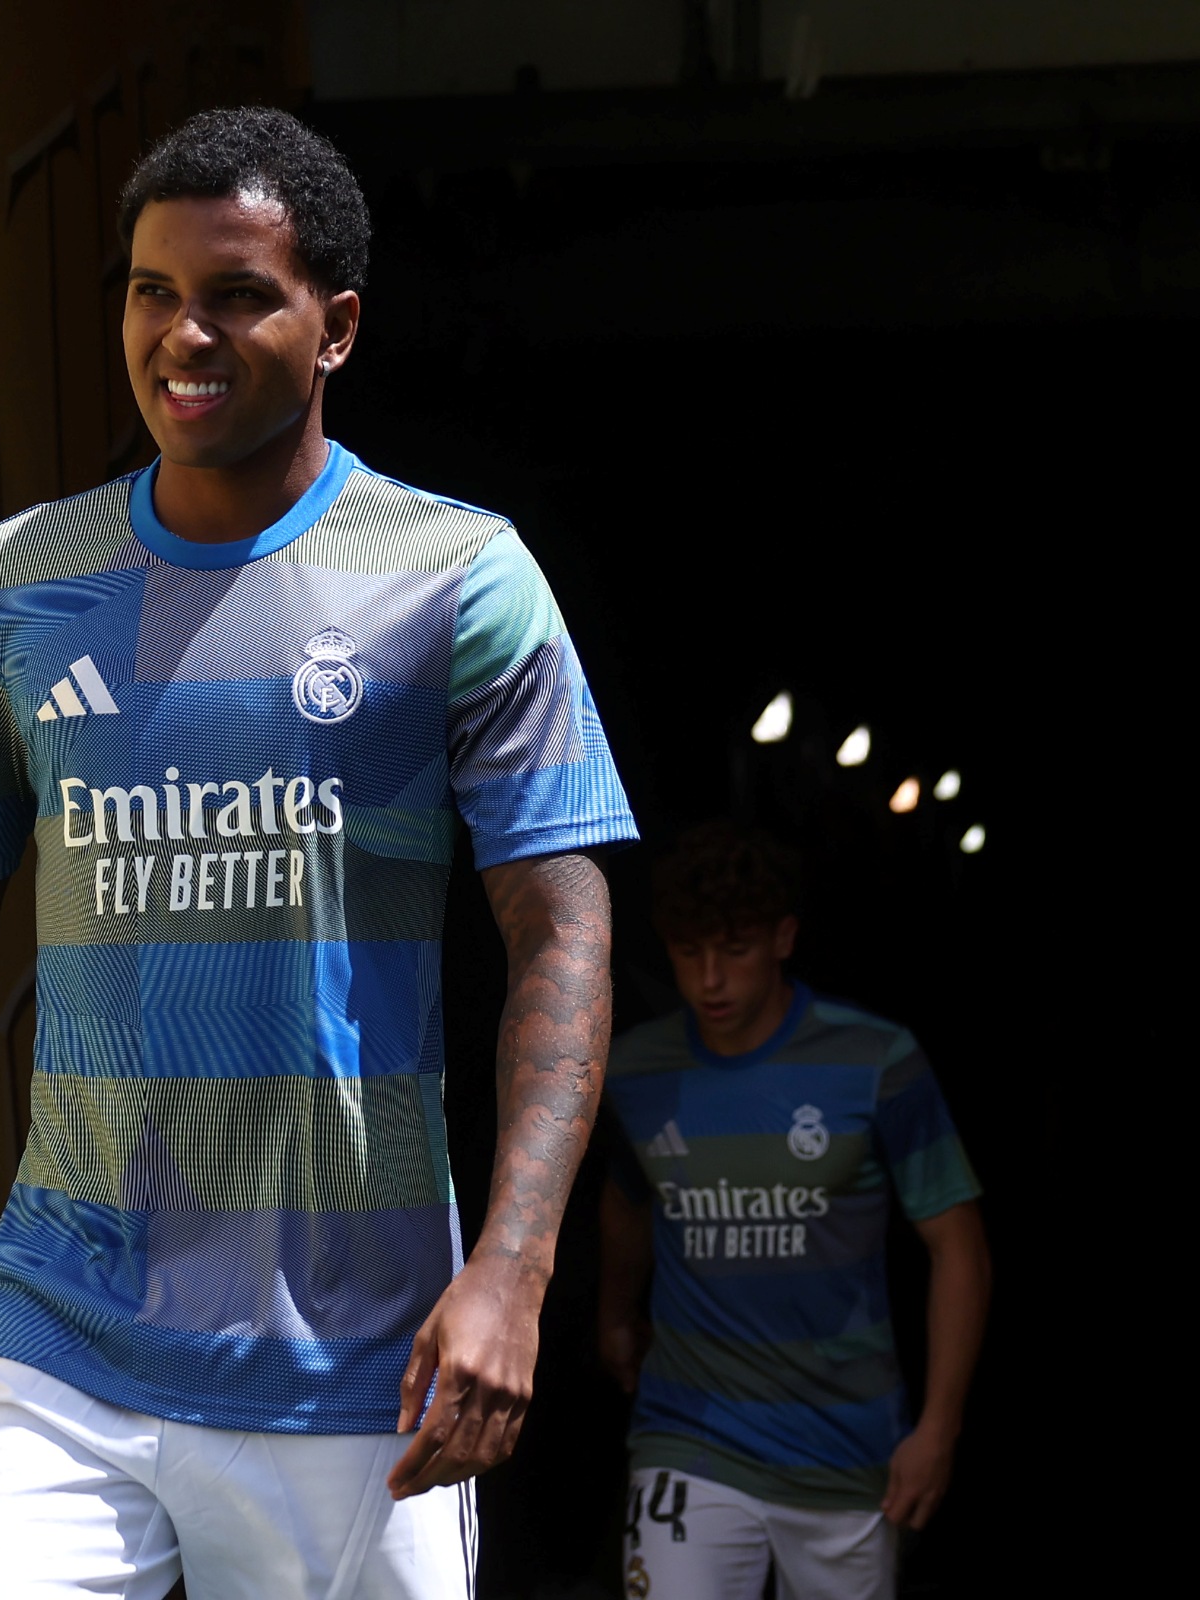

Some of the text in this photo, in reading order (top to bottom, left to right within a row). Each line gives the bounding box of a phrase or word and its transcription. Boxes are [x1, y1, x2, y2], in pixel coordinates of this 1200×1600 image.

[59, 766, 344, 848] Emirates
[95, 849, 305, 915] FLY BETTER
[657, 1177, 831, 1221] Emirates
[684, 1223, 807, 1260] FLY BETTER
